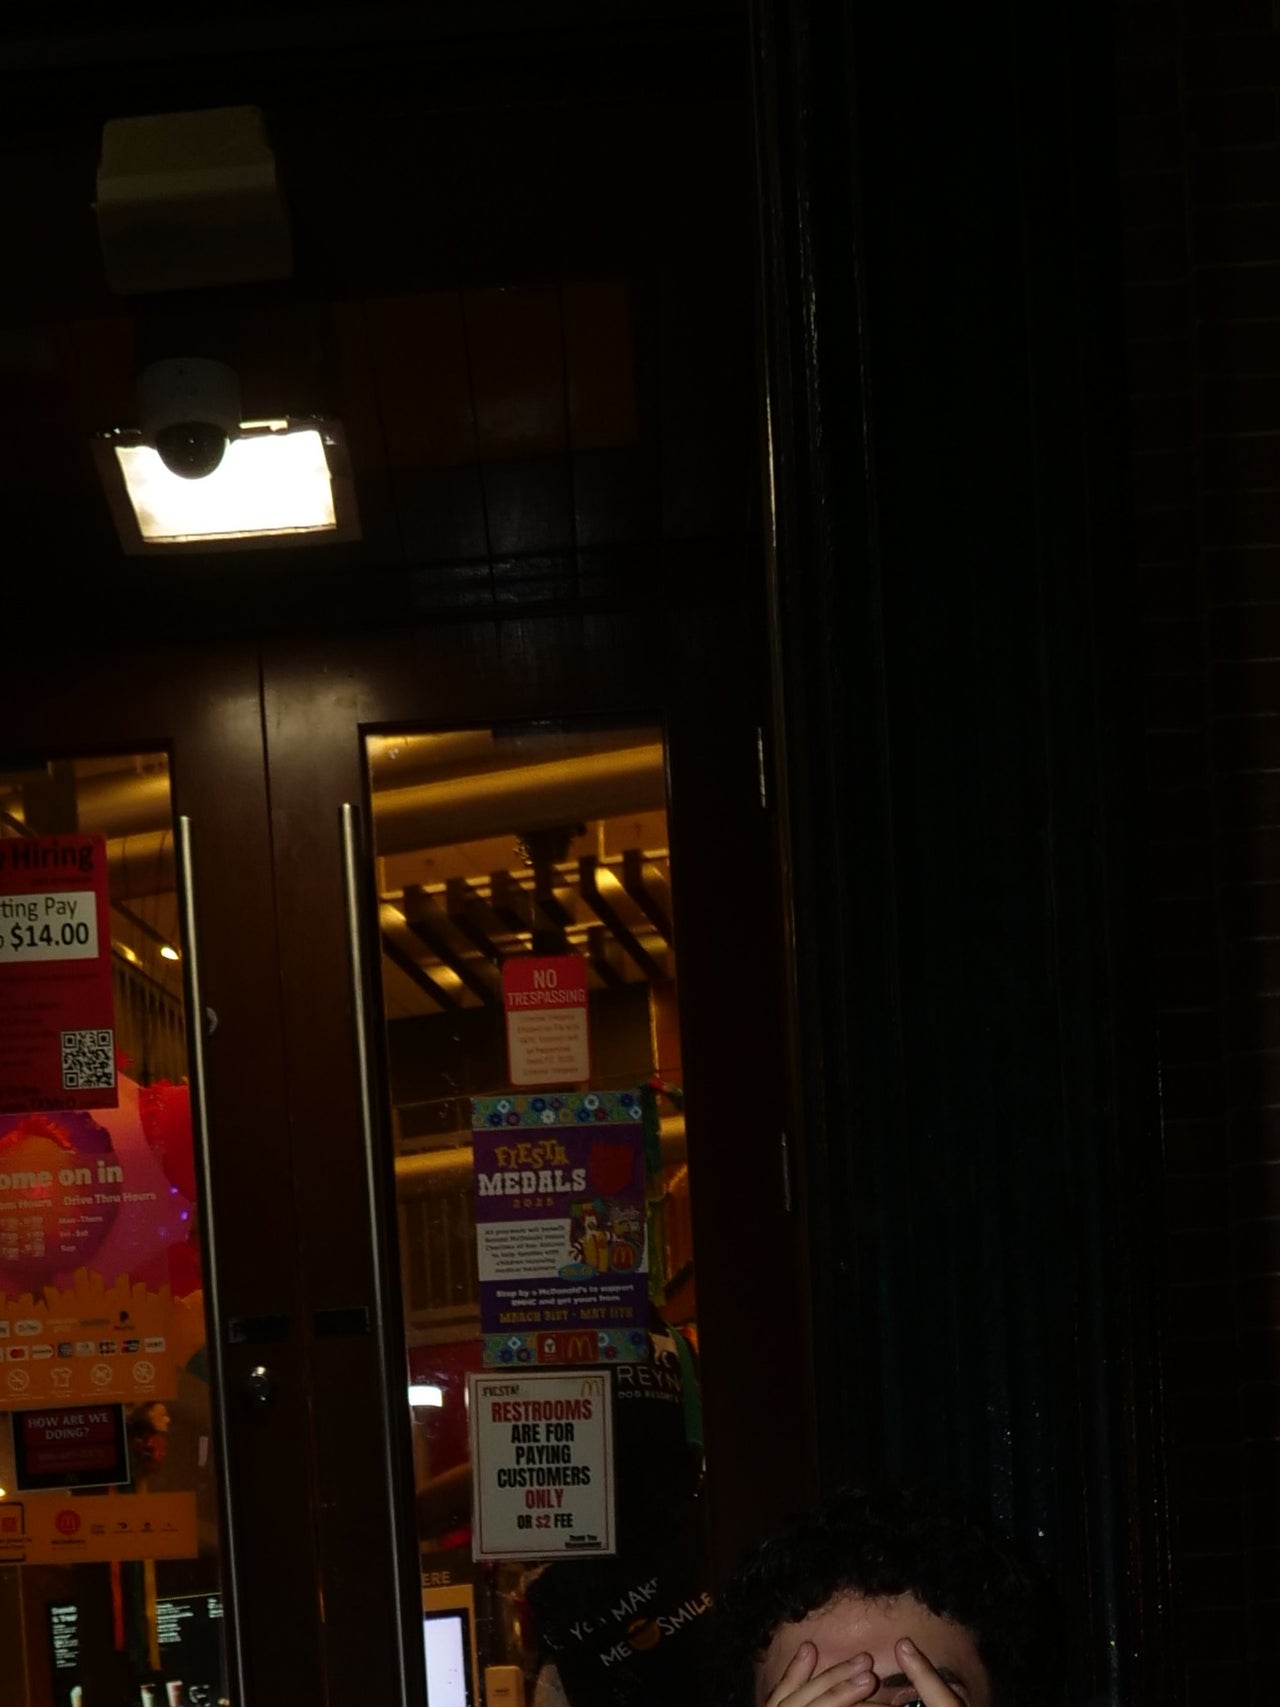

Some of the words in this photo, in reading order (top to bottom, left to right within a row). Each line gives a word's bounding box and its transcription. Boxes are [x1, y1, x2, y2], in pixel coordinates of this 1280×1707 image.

[11, 841, 94, 873] Hiring
[44, 896, 78, 919] Pay
[10, 921, 90, 952] $14.00
[532, 968, 558, 990] NO
[507, 988, 586, 1007] TRESPASSING
[494, 1137, 570, 1170] FIESTA
[58, 1168, 92, 1186] on
[97, 1160, 124, 1184] in
[477, 1168, 587, 1197] MEDALS
[63, 1194, 93, 1207] Drive
[94, 1193, 121, 1205] Thru
[122, 1191, 158, 1203] Hours
[28, 1416, 59, 1430] HOW
[63, 1414, 86, 1427] ARE
[88, 1412, 110, 1424] WE
[491, 1399, 593, 1423] RESTROOMS
[45, 1427, 91, 1441] DOING?
[511, 1424, 540, 1444] ARE
[546, 1423, 575, 1442] FOR
[515, 1444, 571, 1465] PAYING
[497, 1466, 591, 1488] CUSTOMERS
[525, 1489, 564, 1508] ONLY
[517, 1515, 532, 1529] OR
[535, 1514, 551, 1528] $2
[554, 1513, 573, 1528] FEE
[599, 1640, 634, 1667] ME
